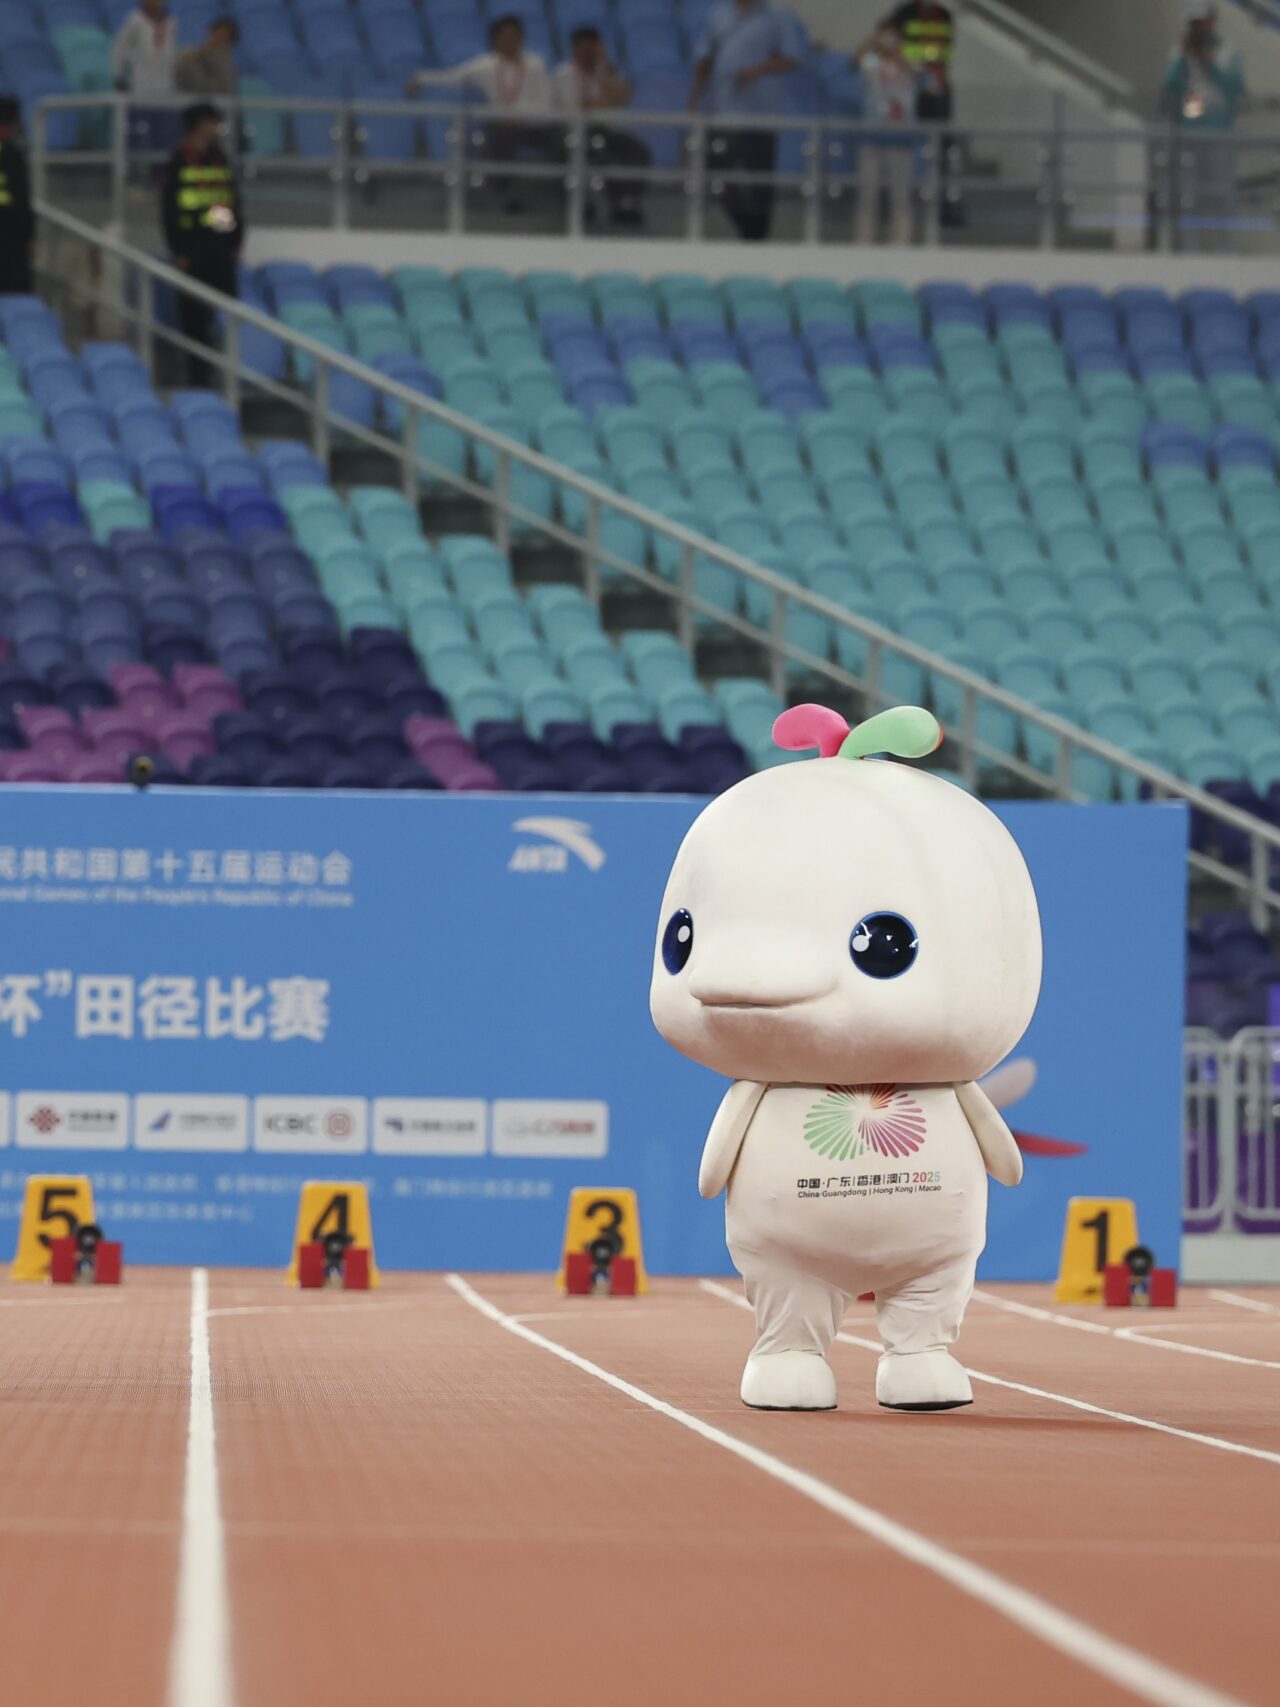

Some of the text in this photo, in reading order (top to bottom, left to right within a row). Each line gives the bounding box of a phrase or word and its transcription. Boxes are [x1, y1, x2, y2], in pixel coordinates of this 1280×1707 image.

[873, 1186, 893, 1196] Hong
[894, 1184, 913, 1194] Kong
[918, 1184, 942, 1192] Macao
[912, 1171, 941, 1184] 2025
[35, 1187, 77, 1248] 5
[312, 1192, 354, 1241] 4
[584, 1200, 624, 1252] 3
[1081, 1210, 1109, 1274] 1
